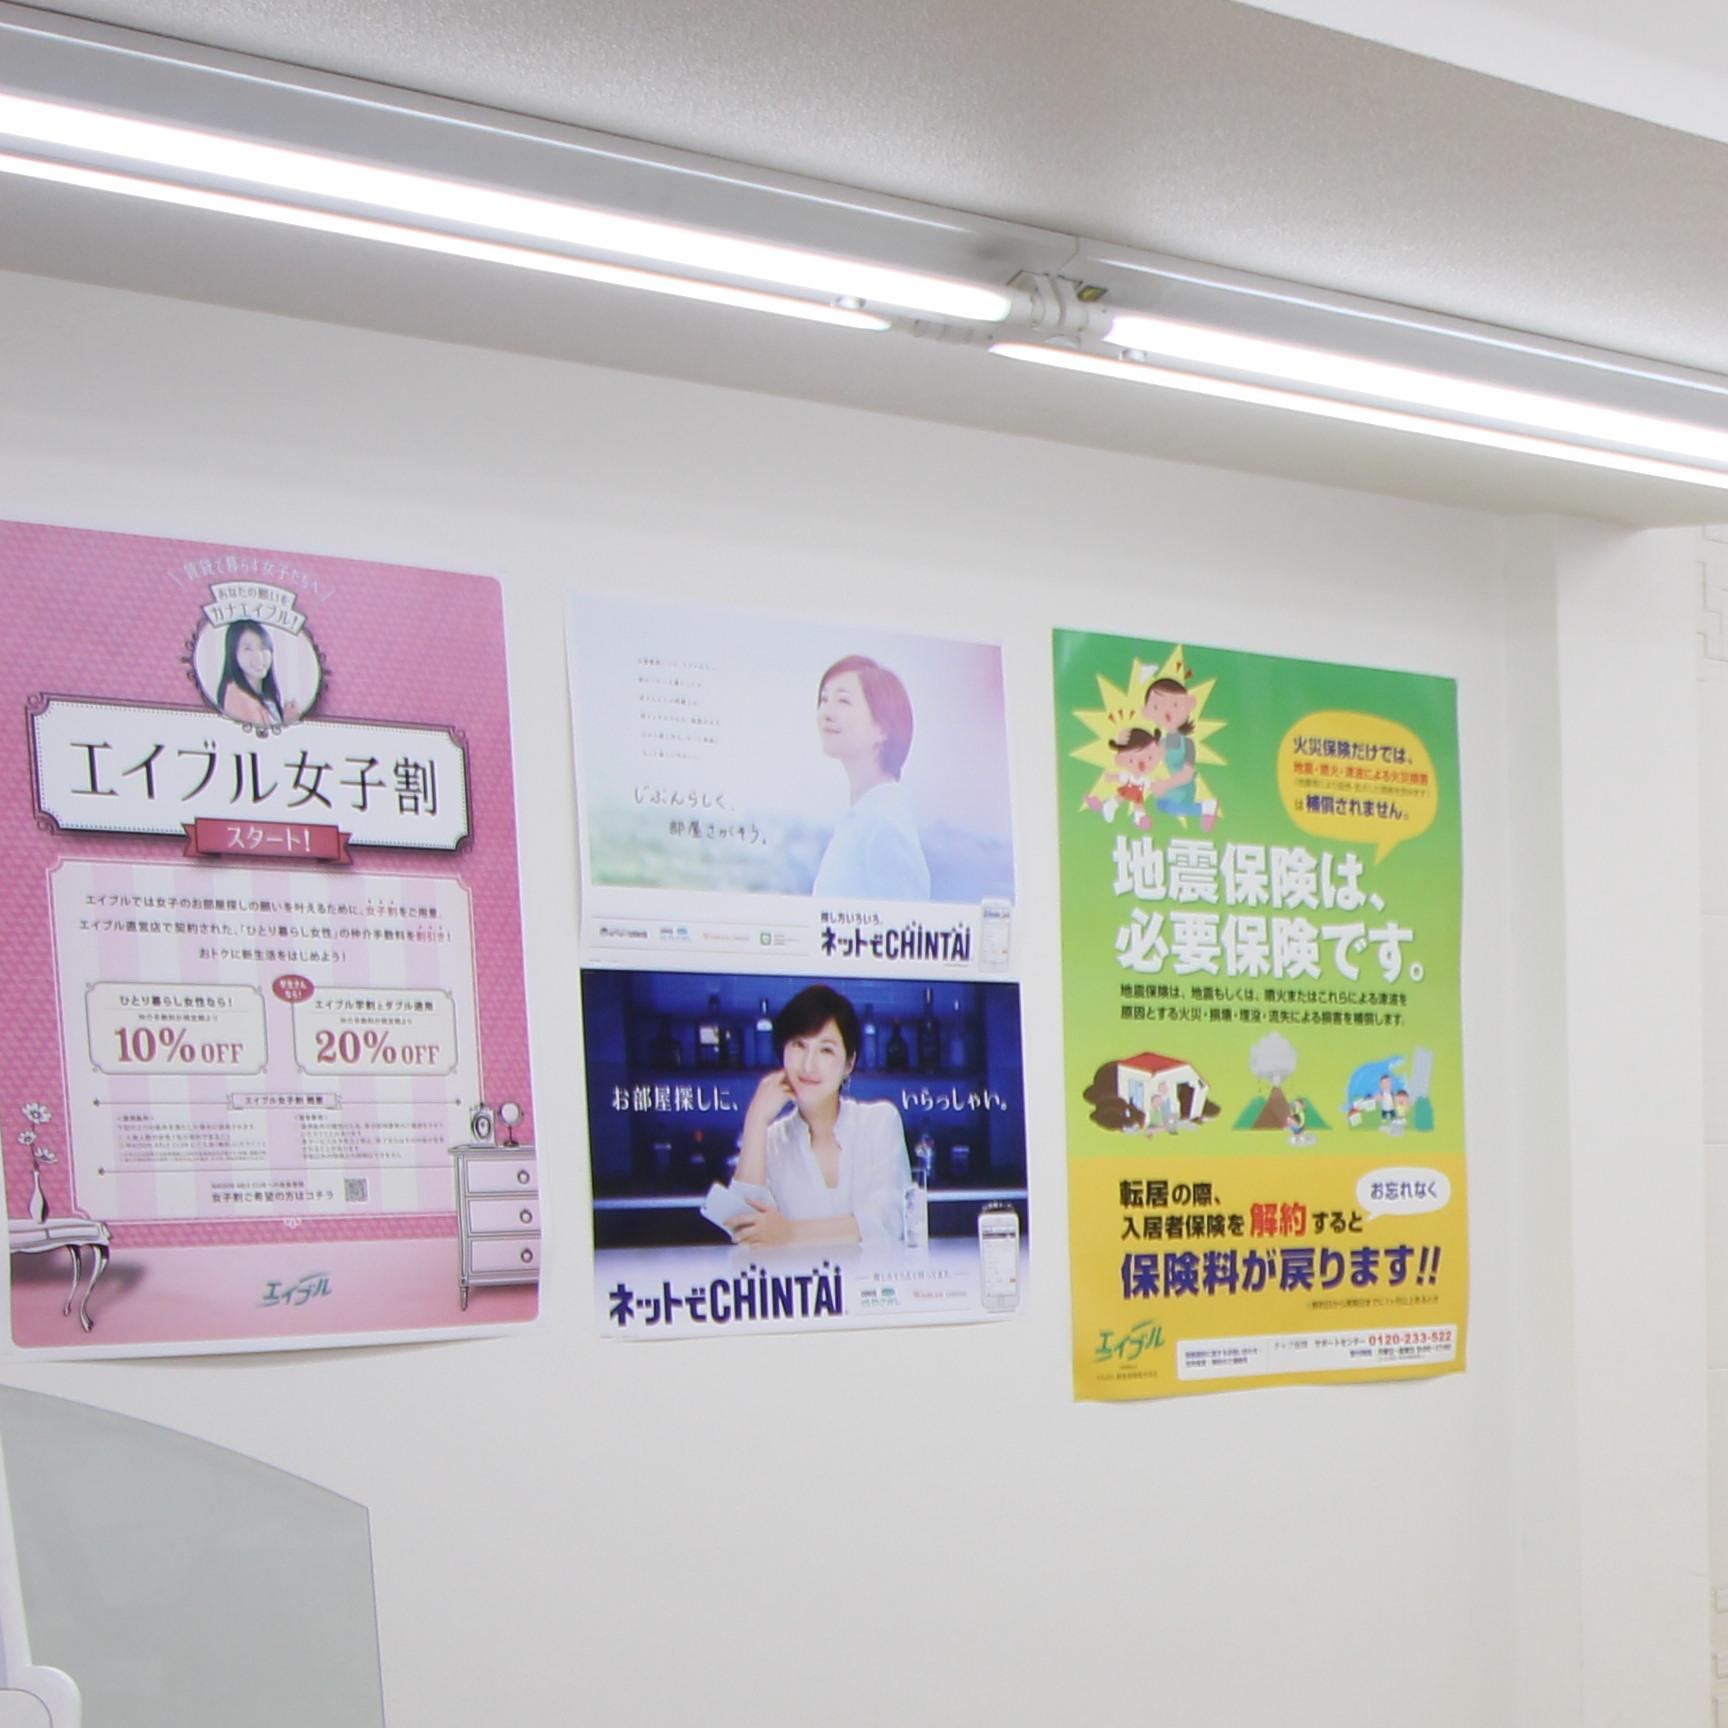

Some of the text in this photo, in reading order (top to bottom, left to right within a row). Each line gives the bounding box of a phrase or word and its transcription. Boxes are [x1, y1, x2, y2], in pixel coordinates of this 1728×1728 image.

[1293, 735, 1414, 765] 火災保険だけでは、
[70, 740, 438, 817] エイブル女子割
[226, 824, 312, 852] スタート!
[1112, 834, 1386, 913] 地震保険は、
[1114, 907, 1426, 984] 必要保険です。
[114, 1026, 244, 1064] 10% OFF
[315, 1029, 441, 1065] 20% OFF
[612, 1084, 739, 1112] お部屋探しに、
[901, 1086, 1008, 1111] いらっしゃい。
[1119, 1179, 1222, 1208] 転居の際、
[1370, 1180, 1437, 1200] お忘れなく
[1120, 1244, 1442, 1299] 保険料が戻ります!!
[257, 1273, 332, 1307] エイブル
[1095, 1319, 1165, 1362] エイブル
[1368, 1331, 1453, 1347] 0120-233-522
